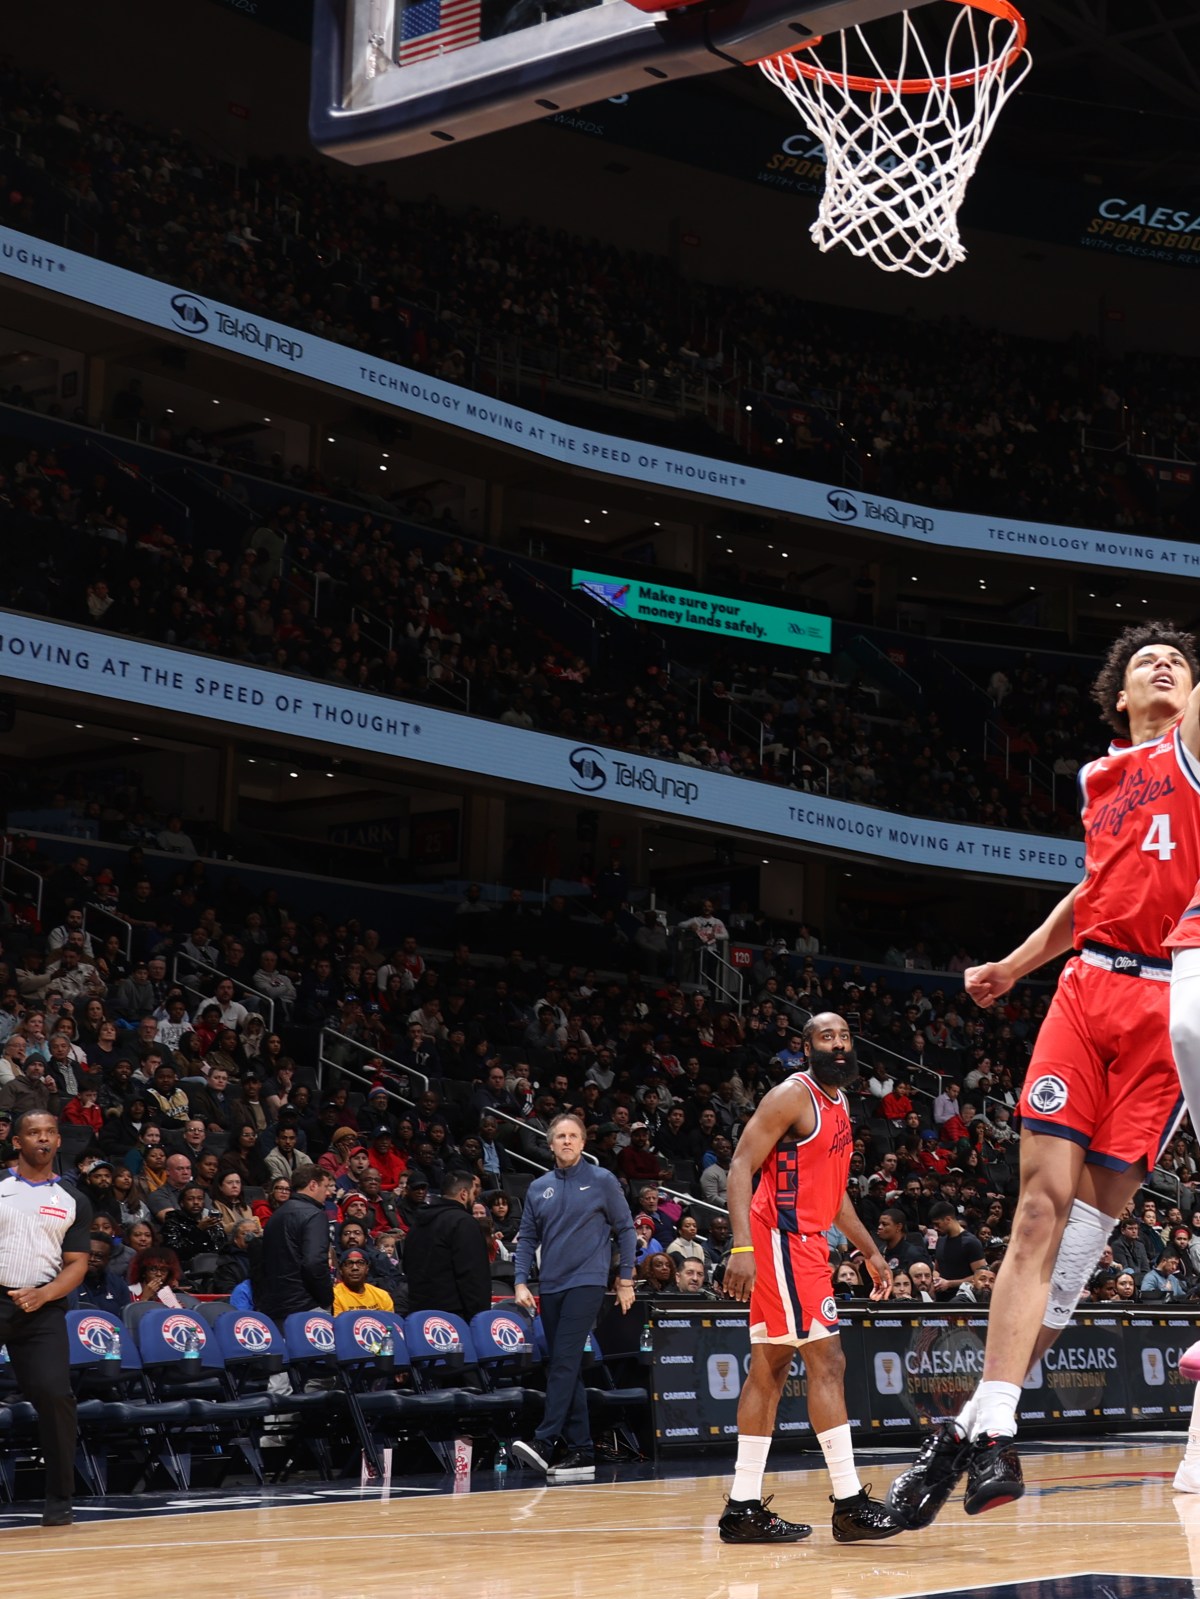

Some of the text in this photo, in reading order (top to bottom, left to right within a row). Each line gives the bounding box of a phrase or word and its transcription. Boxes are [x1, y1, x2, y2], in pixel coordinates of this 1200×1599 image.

[1114, 244, 1174, 261] CAESARS
[215, 311, 303, 361] TekSynap
[360, 367, 460, 410] TECHNOLOGY
[466, 404, 523, 433] MOVING
[529, 427, 545, 440] AT
[550, 433, 575, 450] THE
[583, 442, 631, 464] SPEED
[638, 456, 658, 469] OF
[862, 500, 934, 534] TekSynap
[988, 528, 1089, 551] TECHNOLOGY
[1096, 543, 1154, 560] MOVING
[1160, 552, 1177, 562] AT
[639, 586, 741, 620] Make sure your
[638, 604, 682, 624] money
[686, 611, 721, 628] lands
[724, 621, 768, 638] safely.
[0, 635, 89, 670] OVING
[102, 657, 130, 677] AT
[140, 665, 183, 689] THE
[195, 678, 264, 706] SPEED
[276, 694, 302, 714] OF
[612, 760, 698, 805] TekSynap
[1112, 767, 1146, 805] Los
[1088, 774, 1176, 836] Angeles
[330, 821, 396, 846] CLARK
[425, 832, 444, 854] 25
[789, 806, 883, 838] TECHNOLOGY
[889, 829, 948, 850] MOVING
[956, 841, 975, 854] AT
[982, 844, 1010, 859] THE
[1018, 849, 1067, 867] SPEED
[1141, 813, 1177, 861] 4
[734, 951, 751, 964] 120
[1114, 955, 1138, 970] Clips
[904, 1350, 985, 1375] CAESARS
[1044, 1347, 1118, 1371] CAESARS
[1047, 1372, 1108, 1389] SPORTSBOOK
